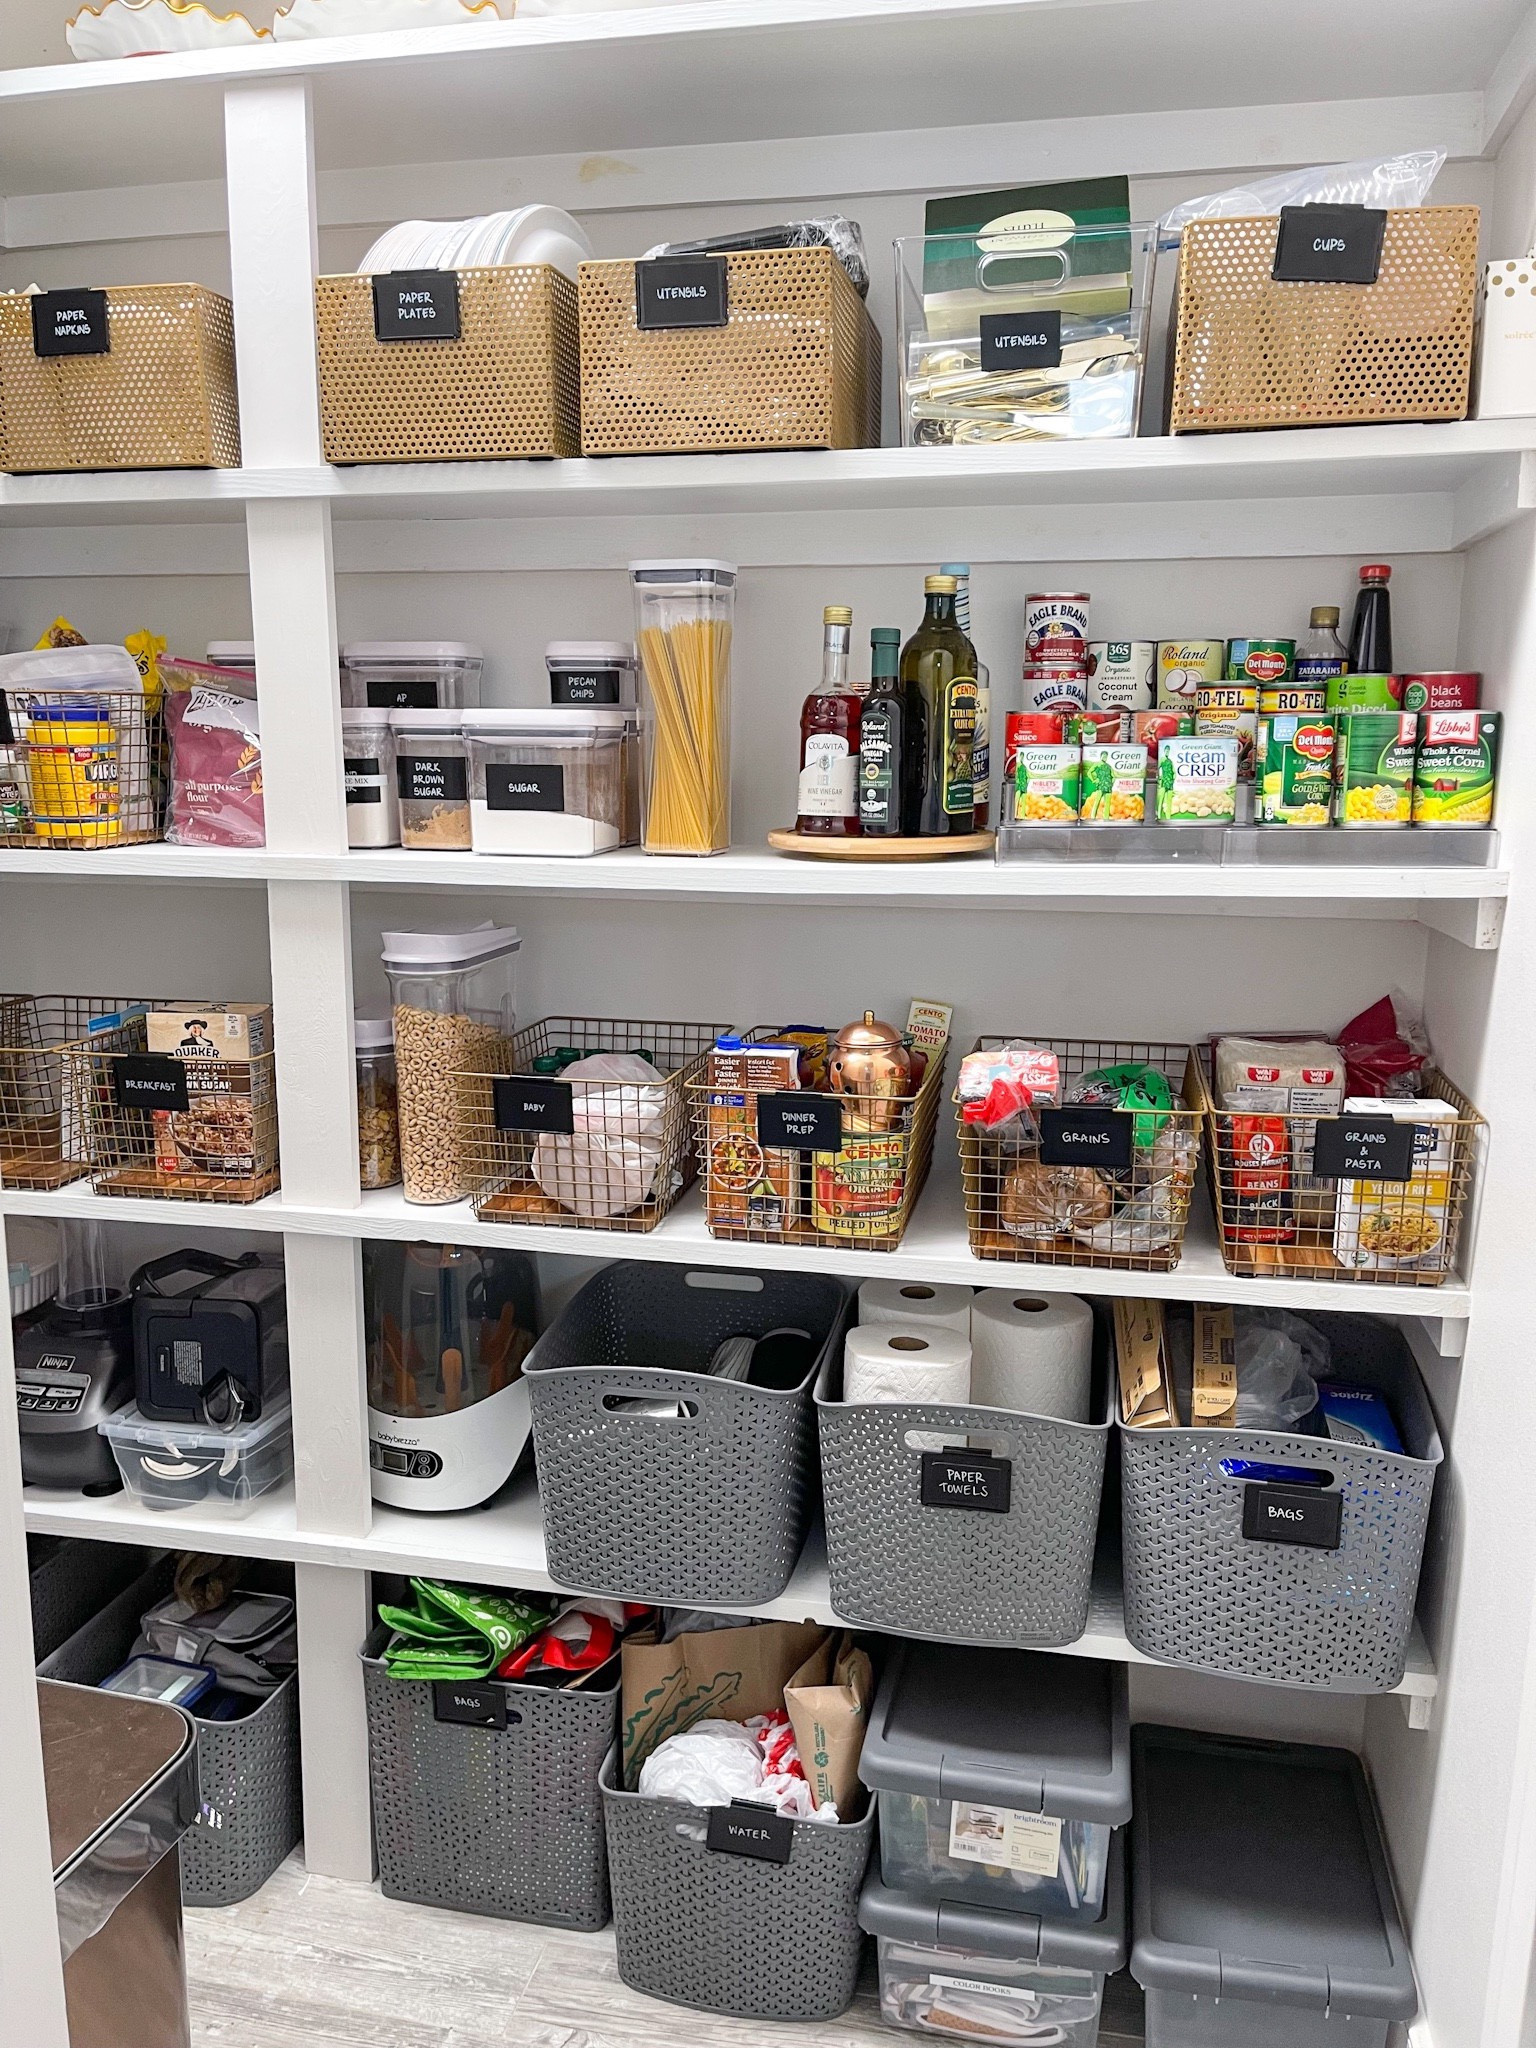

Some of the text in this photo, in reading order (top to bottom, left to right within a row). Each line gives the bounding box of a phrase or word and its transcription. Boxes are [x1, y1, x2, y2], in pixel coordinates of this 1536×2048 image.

[1313, 238, 1345, 251] CUPS
[399, 292, 433, 304] PAPER
[657, 286, 706, 299] UTENSILS
[57, 310, 87, 322] PAPER
[398, 307, 436, 319] PLATES
[55, 324, 90, 336] NAPKINS
[995, 334, 1047, 348] UTENSILS
[1029, 604, 1057, 628] EAGLE
[1060, 604, 1088, 628] BRAND
[1109, 644, 1130, 656] 365
[1163, 645, 1210, 660] Roland
[1249, 659, 1285, 669] Del Monte
[1105, 665, 1131, 675] Organic
[568, 677, 596, 686] PECAN
[1098, 682, 1138, 691] Coconut
[571, 689, 594, 698] CHIPS
[956, 685, 975, 696] CENTO
[1033, 684, 1087, 707] EAGLE BRAN
[1431, 685, 1461, 696] black
[187, 690, 244, 713] Ziploc
[397, 694, 407, 702] AP
[1101, 692, 1133, 701] Cream
[1159, 700, 1196, 711] Cocon
[1352, 703, 1387, 713] Diced
[1430, 697, 1463, 708] beans
[1200, 712, 1237, 720] Original
[861, 720, 887, 732] Roland
[1431, 719, 1471, 736] Libby's
[863, 731, 884, 740] Organic
[1013, 733, 1038, 741] Sauce
[1298, 735, 1314, 745] Del
[808, 741, 845, 751] COLAVITA
[1422, 746, 1481, 756] Whole Kernel
[863, 750, 884, 758] VINEGAR
[1025, 751, 1057, 761] Green
[1110, 750, 1141, 760] Green
[1177, 751, 1226, 764] steam
[415, 762, 441, 772] DARK
[1028, 761, 1058, 771] Giant
[1114, 760, 1141, 770] Giant
[1417, 755, 1486, 768] Sweet Corn
[1177, 763, 1225, 777] CRISP
[413, 775, 444, 784] BROWN
[185, 778, 242, 794] all purpose
[414, 787, 444, 796] SUGAR
[509, 783, 540, 793] SUGAR
[820, 787, 843, 795] VINEGAR
[187, 791, 209, 803] flour
[918, 1009, 943, 1018] CENTO
[908, 1024, 946, 1038] TOMATO
[913, 1033, 940, 1046] PASTE
[175, 1047, 220, 1059] QUAKER
[714, 1057, 740, 1066] Easier
[714, 1070, 741, 1078] Faster
[126, 1080, 176, 1091] BREAKFAST
[524, 1103, 545, 1112] BABY
[782, 1112, 818, 1123] DINNER
[787, 1124, 814, 1134] PREP
[1062, 1132, 1110, 1143] GRAINS
[1345, 1132, 1386, 1143] GRAINS
[845, 1142, 899, 1160] CENTO
[1360, 1146, 1368, 1155] &
[1345, 1158, 1381, 1169] PASTA
[1247, 1179, 1279, 1189] BEANS
[1371, 1183, 1433, 1196] YELLOW RICE
[1249, 1198, 1278, 1212] BLACK
[42, 1356, 69, 1369] NINJA
[1329, 1391, 1374, 1402] Ziploc
[946, 1469, 985, 1484] PAPER
[939, 1481, 988, 1497] TOWELS
[1268, 1506, 1304, 1521] BAGS
[455, 1697, 480, 1707] BAGS
[1014, 1813, 1057, 1828] brightroom
[729, 1825, 770, 1840] WATER
[952, 1980, 1011, 1995] COLOR BOOKS
